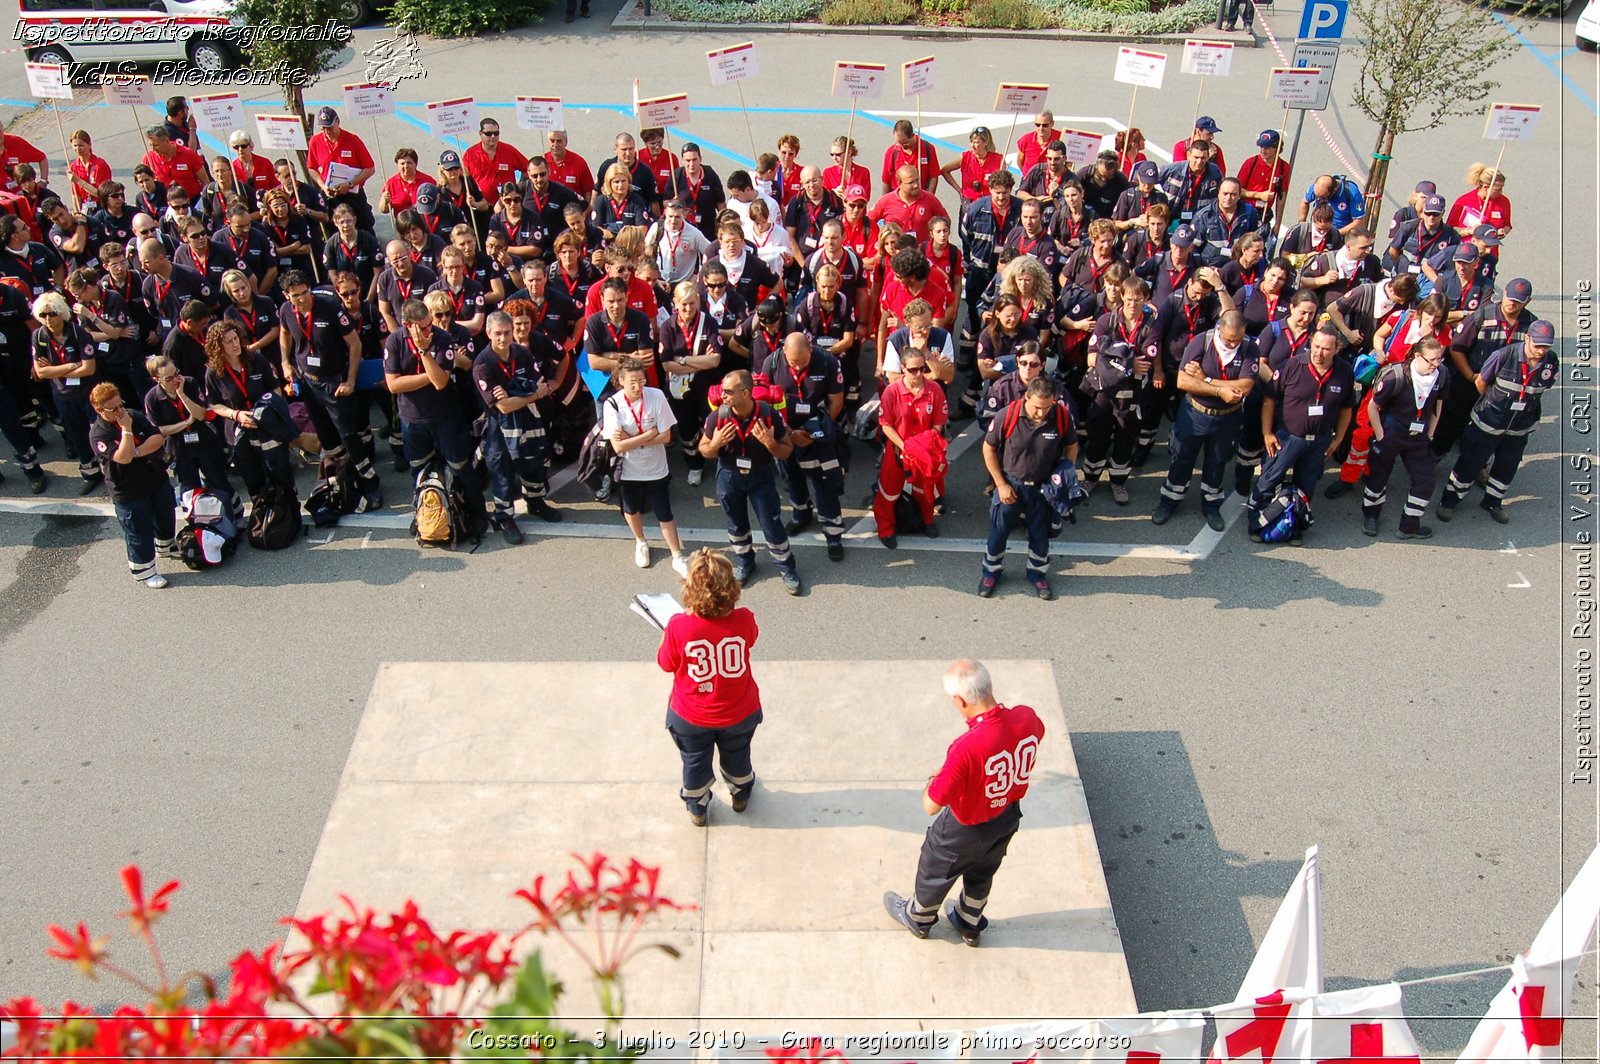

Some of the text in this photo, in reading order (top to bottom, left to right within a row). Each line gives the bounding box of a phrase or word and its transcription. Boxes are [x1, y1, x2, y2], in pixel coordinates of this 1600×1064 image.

[1307, 3, 1339, 38] P
[684, 635, 747, 683] 30
[984, 734, 1040, 799] 30
